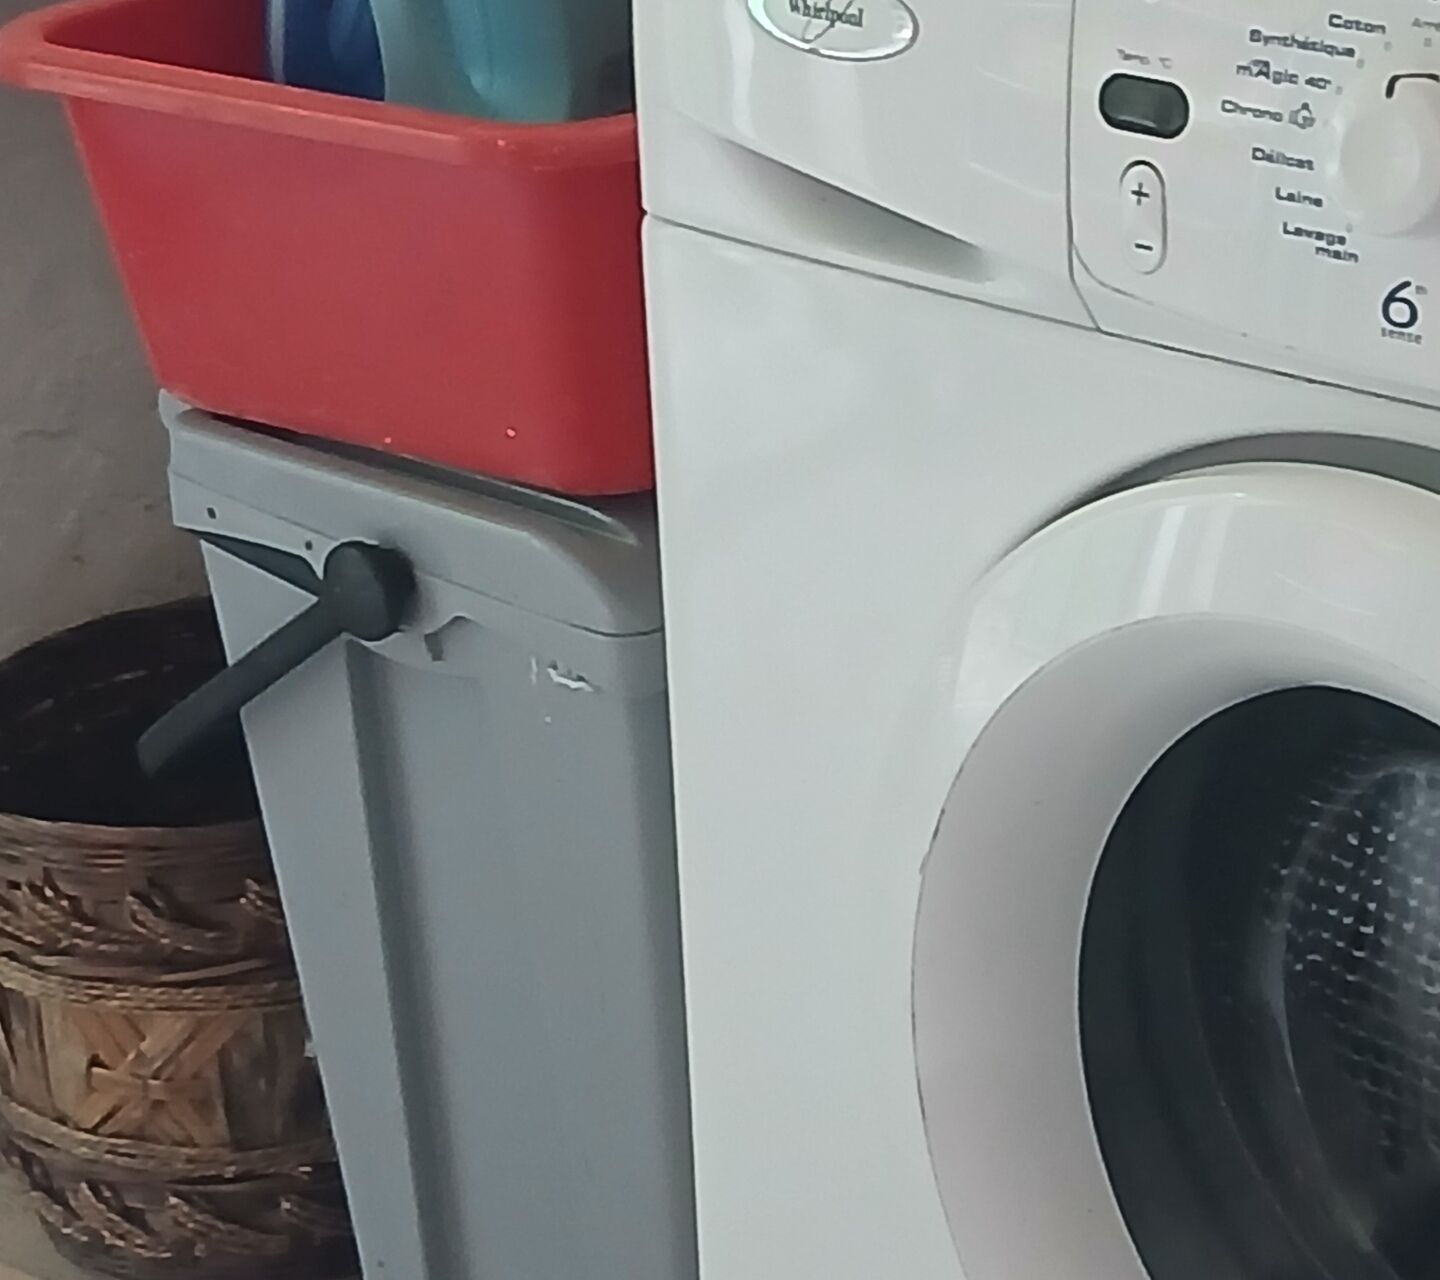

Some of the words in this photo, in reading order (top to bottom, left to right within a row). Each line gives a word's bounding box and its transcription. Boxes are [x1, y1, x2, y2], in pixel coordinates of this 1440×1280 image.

[1328, 13, 1386, 35] Coton
[1275, 186, 1323, 207] Laine
[1315, 246, 1359, 263] main
[1381, 280, 1419, 329] 6
